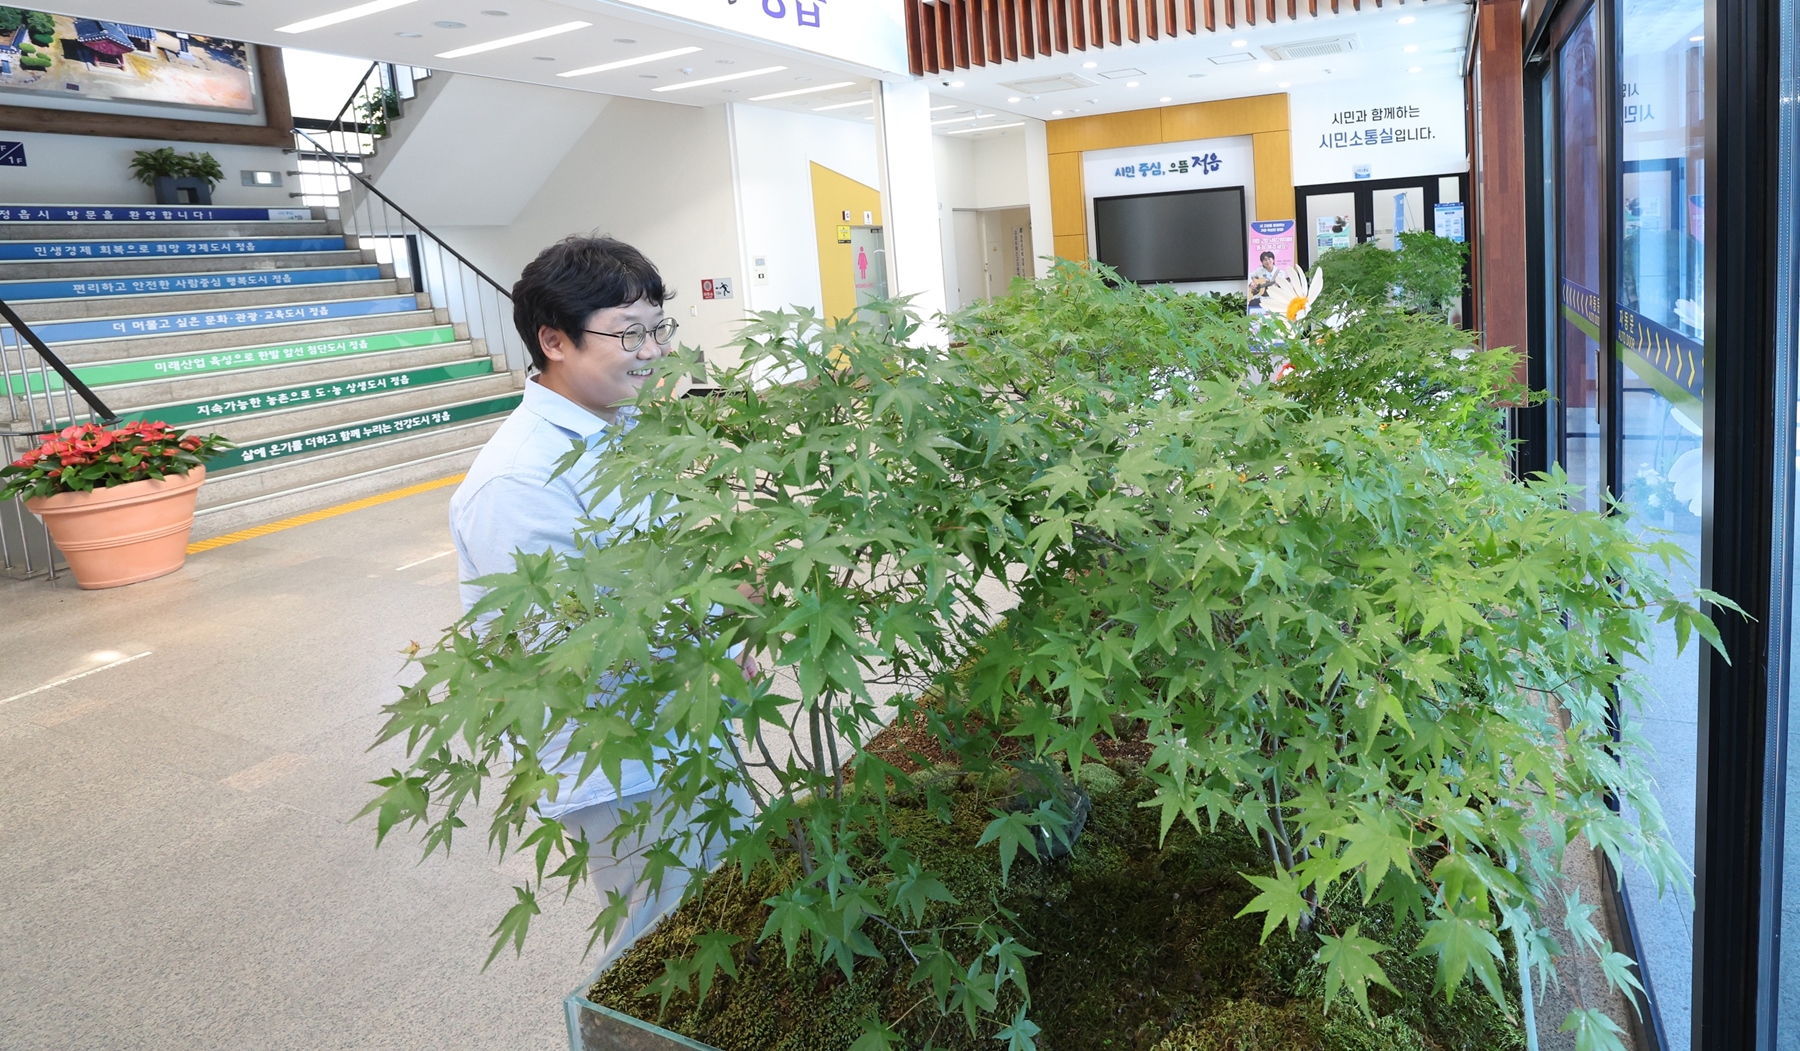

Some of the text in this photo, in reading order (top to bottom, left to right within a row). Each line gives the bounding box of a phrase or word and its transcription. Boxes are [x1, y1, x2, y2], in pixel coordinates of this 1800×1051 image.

[1332, 105, 1420, 125] 시민과 함께하는
[1319, 127, 1436, 149] 시민소통실입니다.
[8, 156, 22, 164] 1F
[1115, 152, 1223, 178] 시민 중심, 으뜸 정읍
[0, 209, 213, 220] 정읍시 방문을 환영합니다!
[34, 242, 255, 257] 민생경제 회복으로 희망 경제도시 정읍
[72, 273, 292, 295] 편리하고 안전한 사람중심 행복도시 정읍
[112, 322, 127, 333] 더
[132, 318, 171, 331] 머물고
[175, 316, 200, 329] 싶은
[308, 305, 329, 317] 정읍
[1619, 309, 1634, 334] 자동문
[154, 338, 369, 373] 미래산업 육성으로 한발 앞선 첨단도시 정읍
[197, 396, 261, 416] 지속가능한
[266, 388, 311, 406] 농촌으로
[346, 378, 387, 394] 상생도시
[390, 374, 410, 386] 정읍
[241, 411, 451, 462] 삶에 온기를 더하고 함께 누리는 건강도시 정읍
